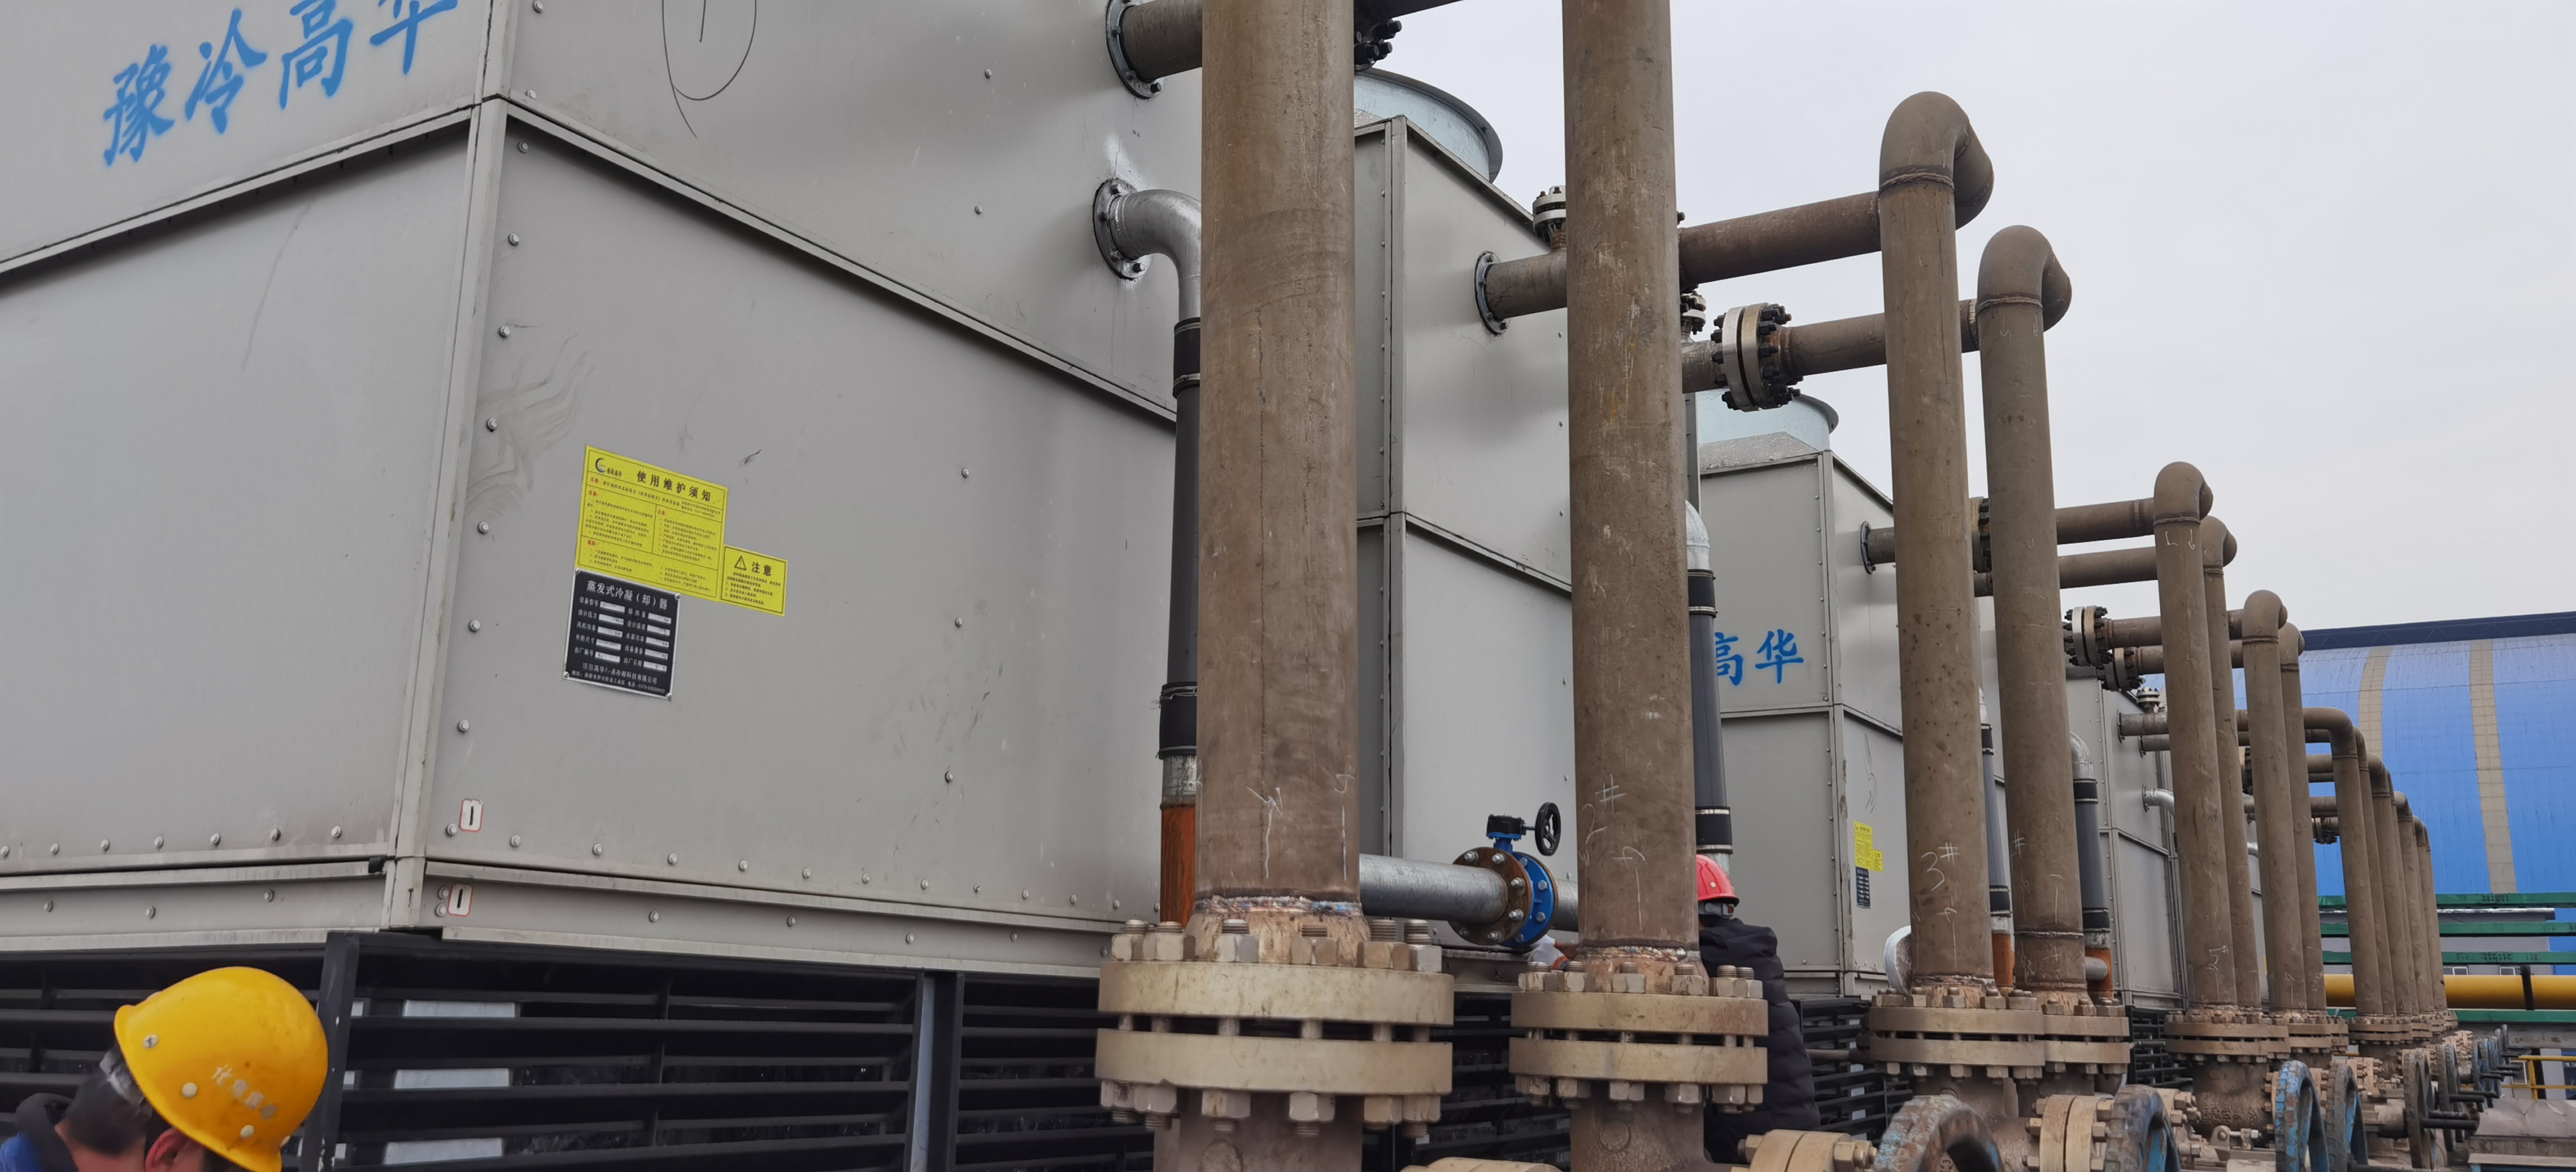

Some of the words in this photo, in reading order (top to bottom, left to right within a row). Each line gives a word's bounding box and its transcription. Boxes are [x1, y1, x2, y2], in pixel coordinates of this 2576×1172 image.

[636, 470, 711, 502] 使用维护须知
[752, 561, 772, 577] 注意
[579, 596, 599, 607] 设备型号
[578, 609, 597, 619] 设计压力
[577, 621, 596, 631] 风机功率
[575, 634, 595, 644] 外形尺寸
[574, 646, 594, 656] 出厂编号
[623, 657, 643, 666] 出厂日期
[1921, 841, 1960, 892] 3#
